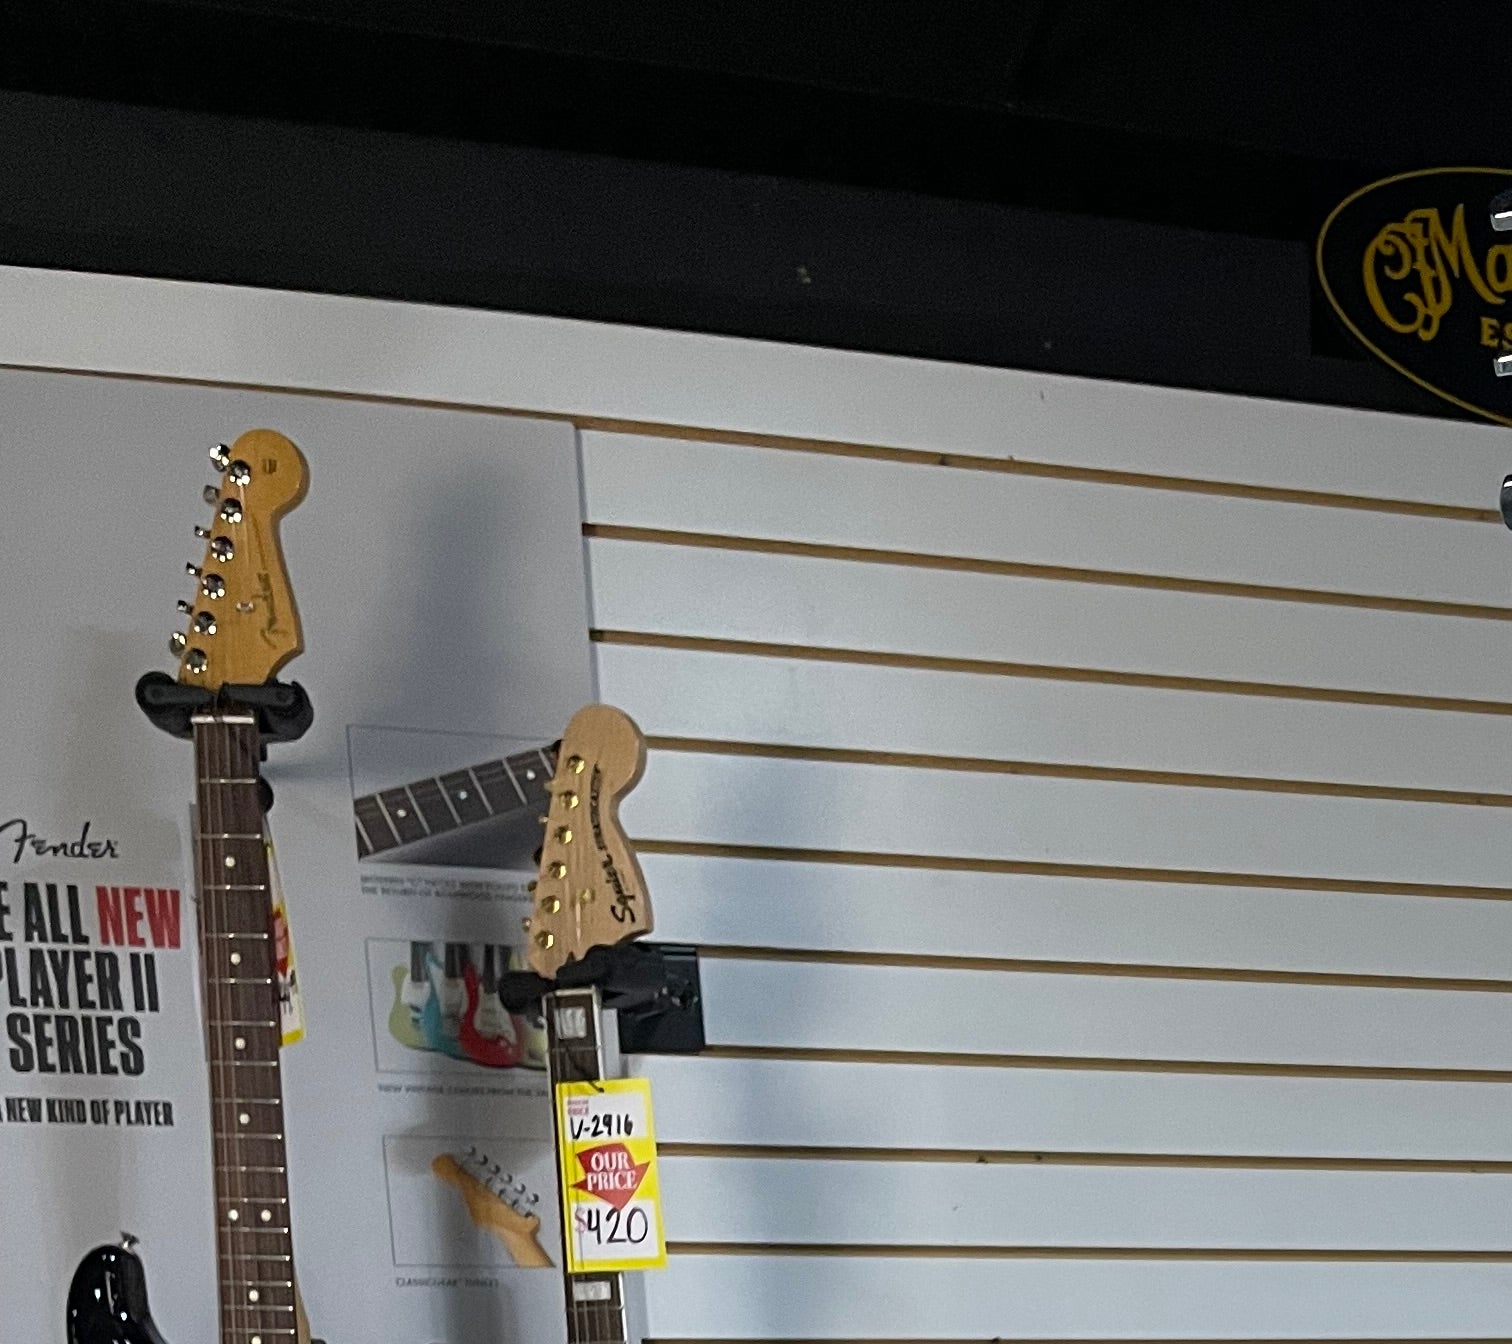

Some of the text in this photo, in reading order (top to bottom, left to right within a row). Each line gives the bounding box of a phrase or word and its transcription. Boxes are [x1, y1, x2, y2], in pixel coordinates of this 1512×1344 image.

[0, 818, 119, 864] Fender
[24, 882, 90, 945] ALL
[96, 885, 181, 949] NEW
[0, 946, 160, 1013] LAYER II
[6, 1012, 145, 1077] SERIES
[5, 1097, 175, 1127] NEW KIND OF PLAYER
[586, 1169, 638, 1191] PRICE
[590, 1151, 630, 1172] OUR
[575, 1206, 649, 1245] $420
